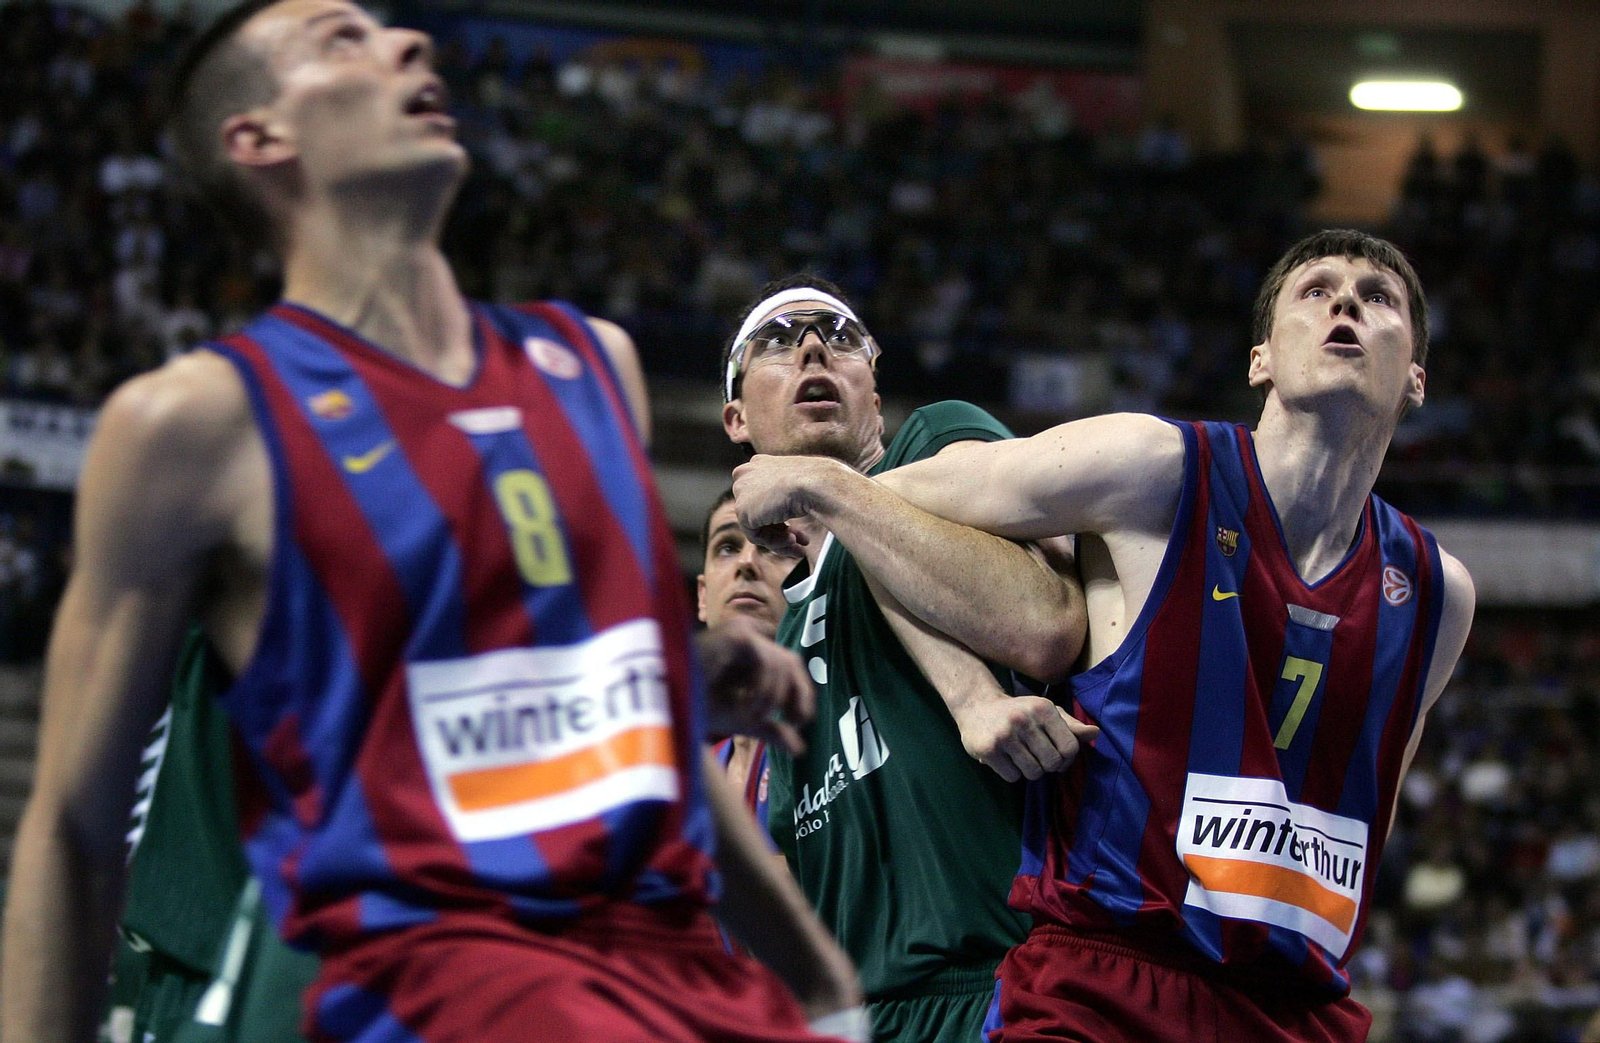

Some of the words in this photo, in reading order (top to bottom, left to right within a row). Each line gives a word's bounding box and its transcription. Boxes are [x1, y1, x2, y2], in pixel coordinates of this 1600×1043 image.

[494, 469, 572, 587] 8
[1273, 656, 1324, 750] 7
[1192, 809, 1362, 890] winterthur
